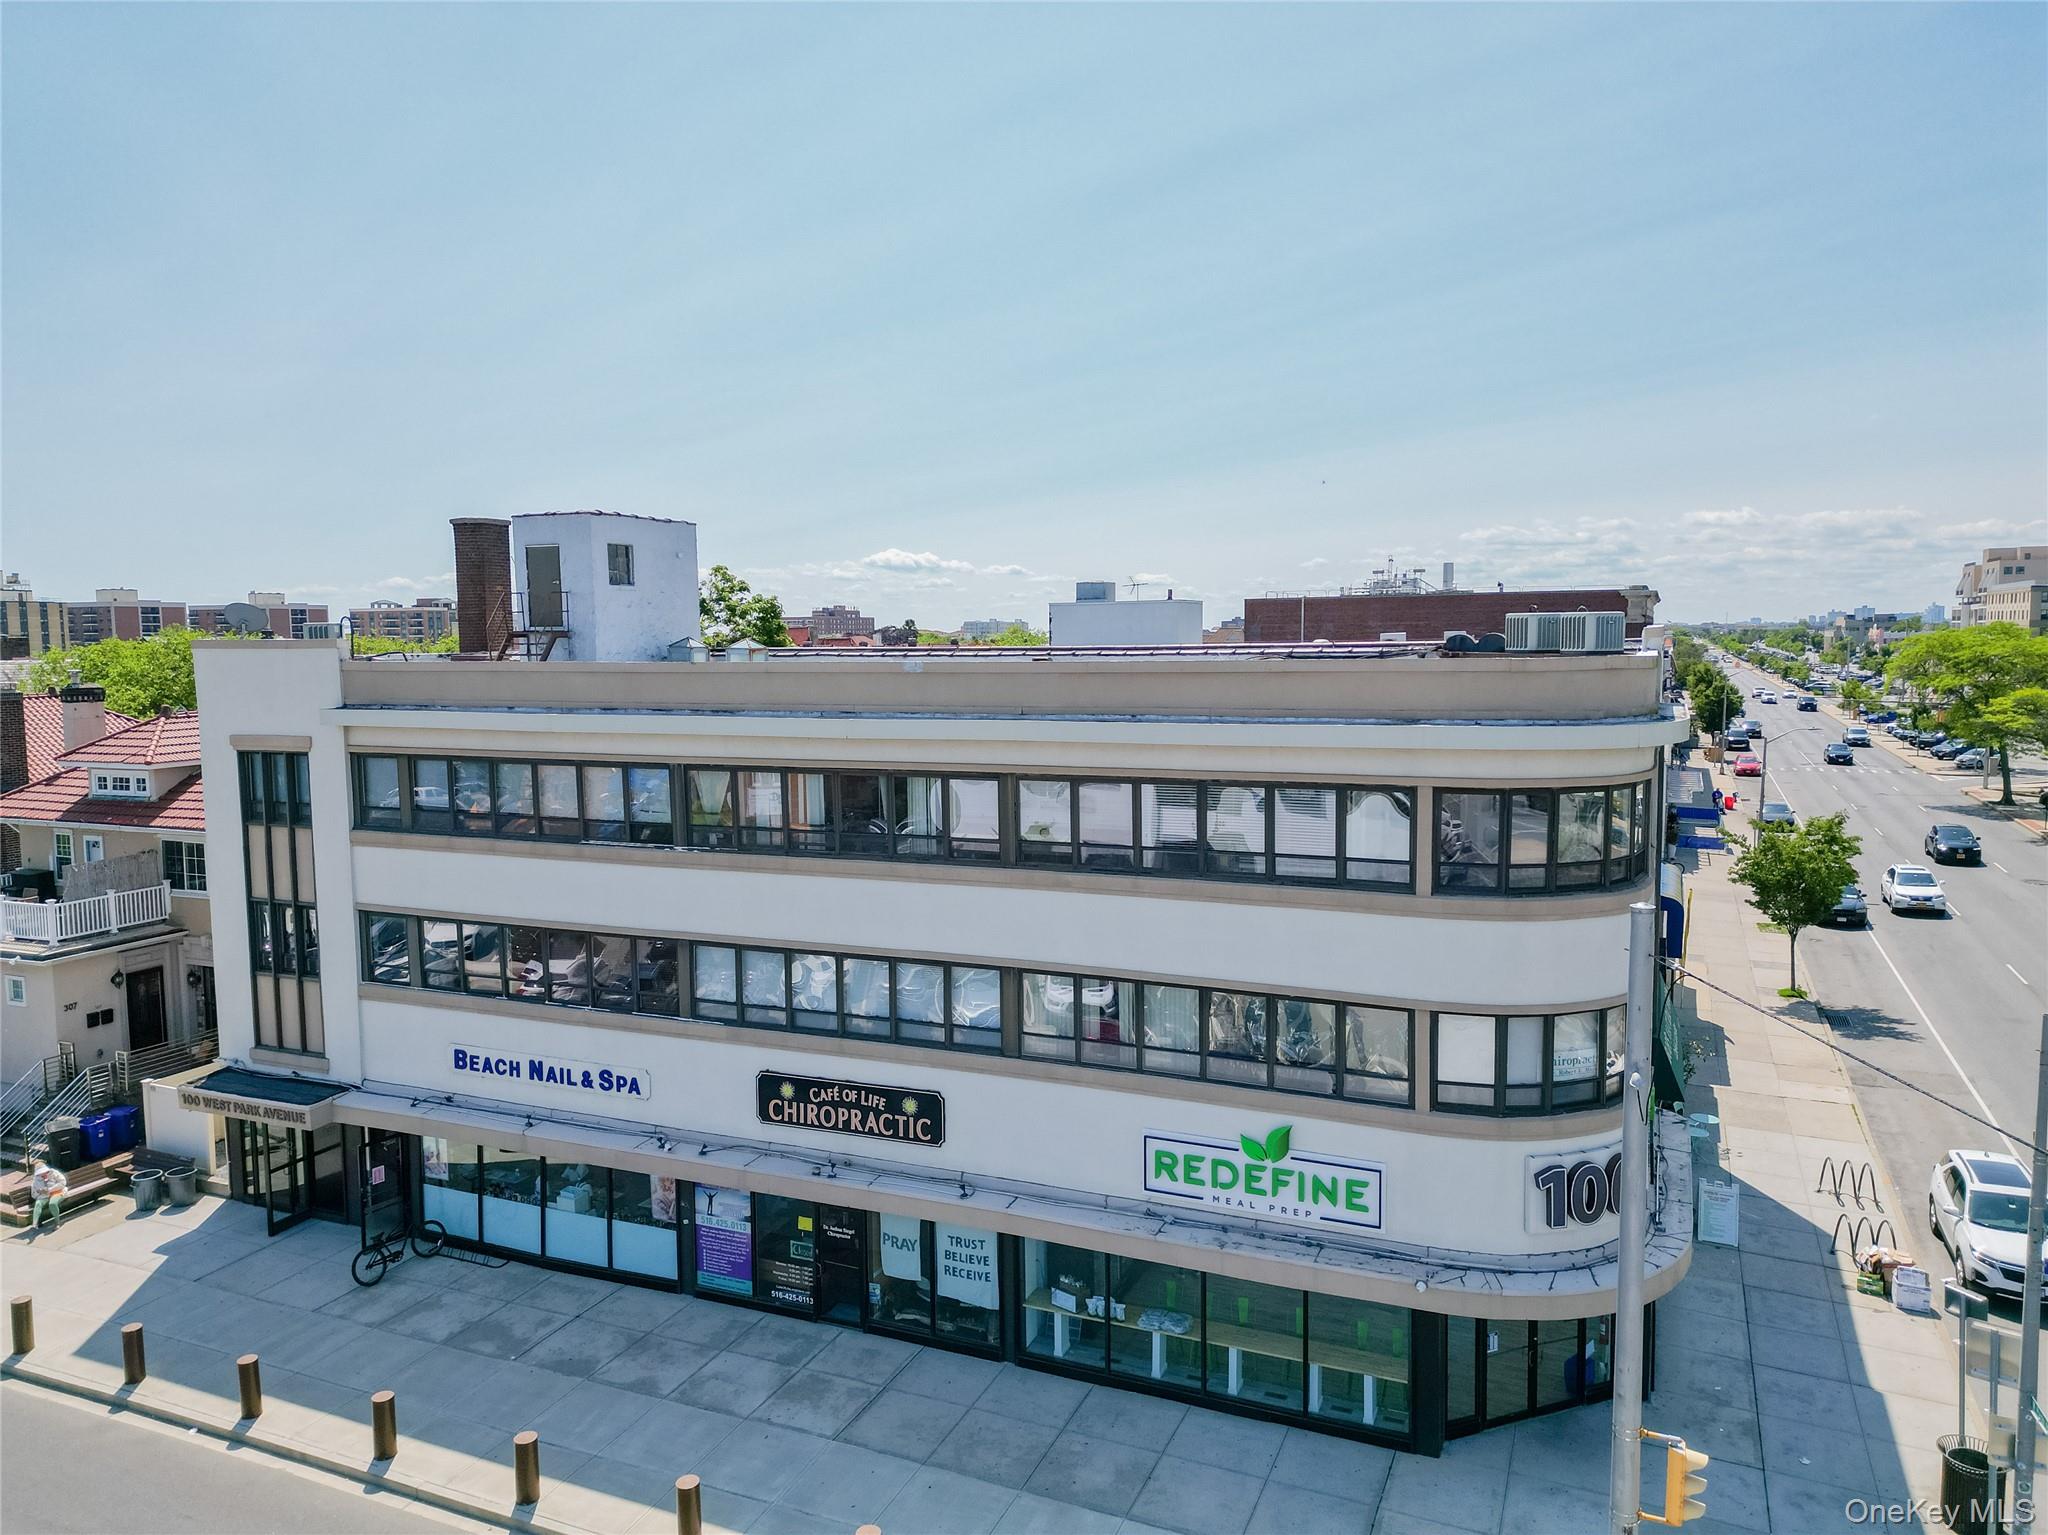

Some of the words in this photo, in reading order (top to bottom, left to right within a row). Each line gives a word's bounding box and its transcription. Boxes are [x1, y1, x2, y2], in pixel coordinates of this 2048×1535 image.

[64, 1002, 77, 1011] 307
[454, 1049, 521, 1078] BEACH
[1553, 1055, 1596, 1066] hiropract
[181, 1093, 201, 1107] 100
[202, 1096, 231, 1113] WEST
[233, 1101, 262, 1117] PARK
[263, 1107, 307, 1124] AVENUE
[842, 1090, 858, 1101] OF
[861, 1091, 886, 1111] LIFE
[768, 1099, 932, 1141] CHIROPRACTIC
[1154, 1149, 1370, 1213] REDEFINE
[1212, 1195, 1256, 1210] MEAL
[1269, 1204, 1312, 1218] PREP
[701, 1215, 747, 1231] 516.425.0113
[882, 1232, 918, 1252] PRAY
[947, 1235, 986, 1250] TRUST
[944, 1249, 990, 1266] BELIEVE
[944, 1265, 992, 1283] RECEIVE
[771, 1291, 814, 1305] 516-425-0113
